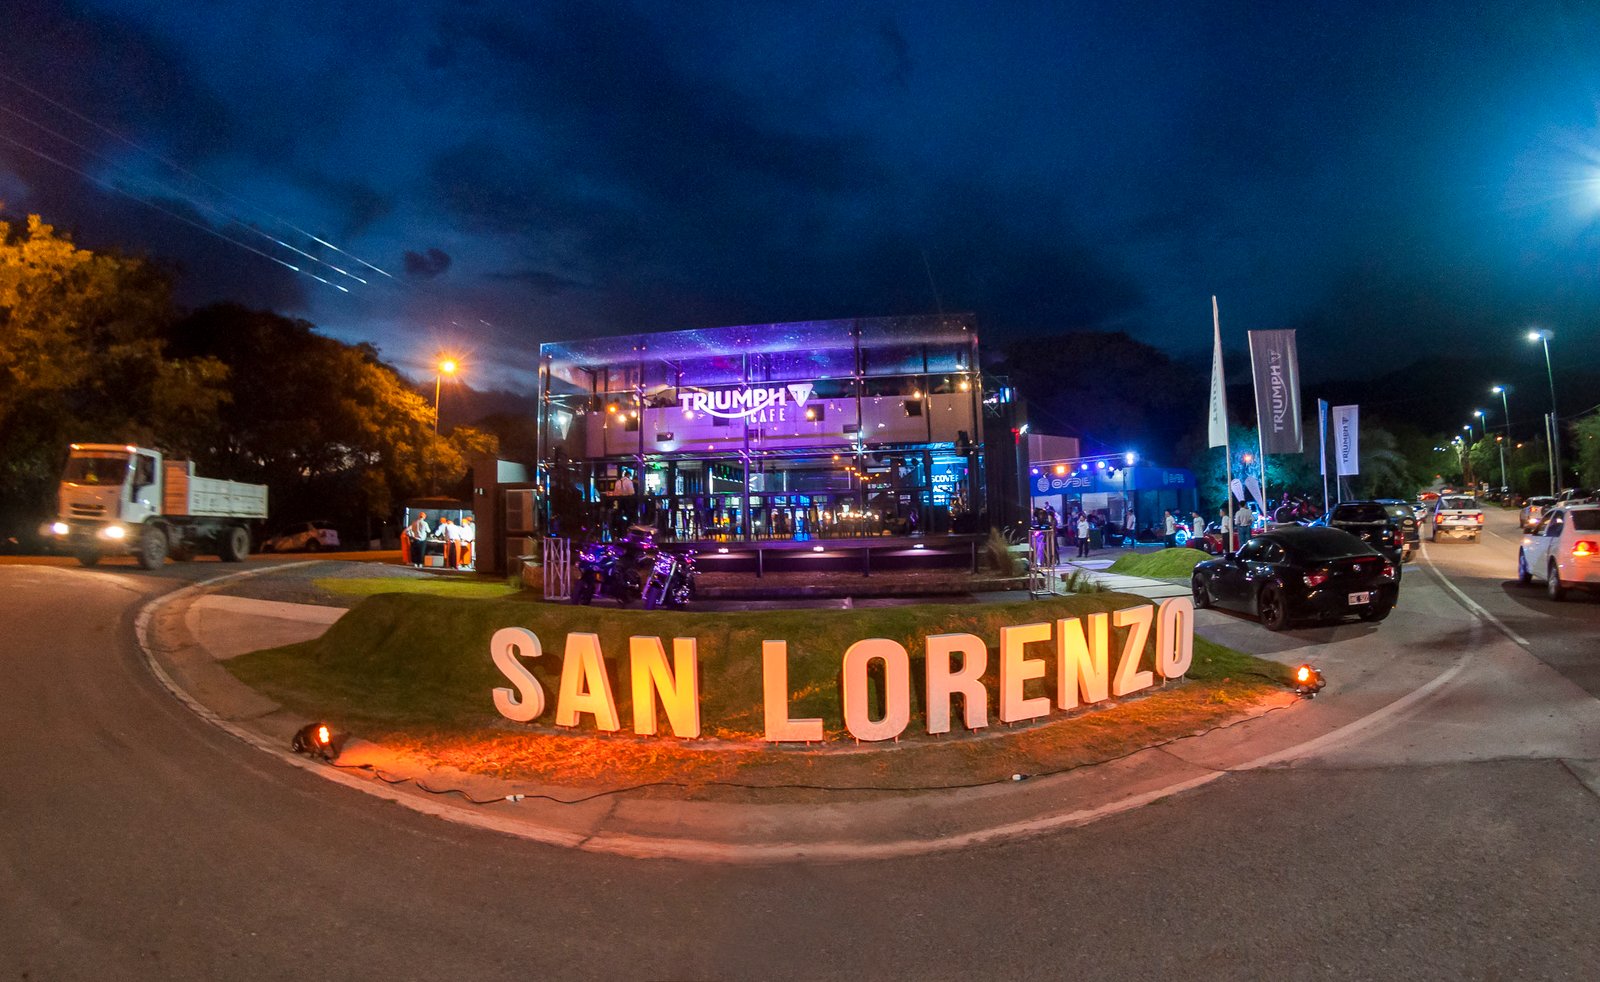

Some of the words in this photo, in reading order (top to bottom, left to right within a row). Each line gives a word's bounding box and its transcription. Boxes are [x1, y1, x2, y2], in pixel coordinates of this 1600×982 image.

[678, 387, 786, 419] TRIUMPH
[1270, 365, 1288, 433] TRIUMPH
[1342, 425, 1351, 464] TRIUMPH
[1051, 477, 1092, 489] OSDE
[490, 626, 701, 739] SAN
[762, 597, 1195, 742] LORENZO
